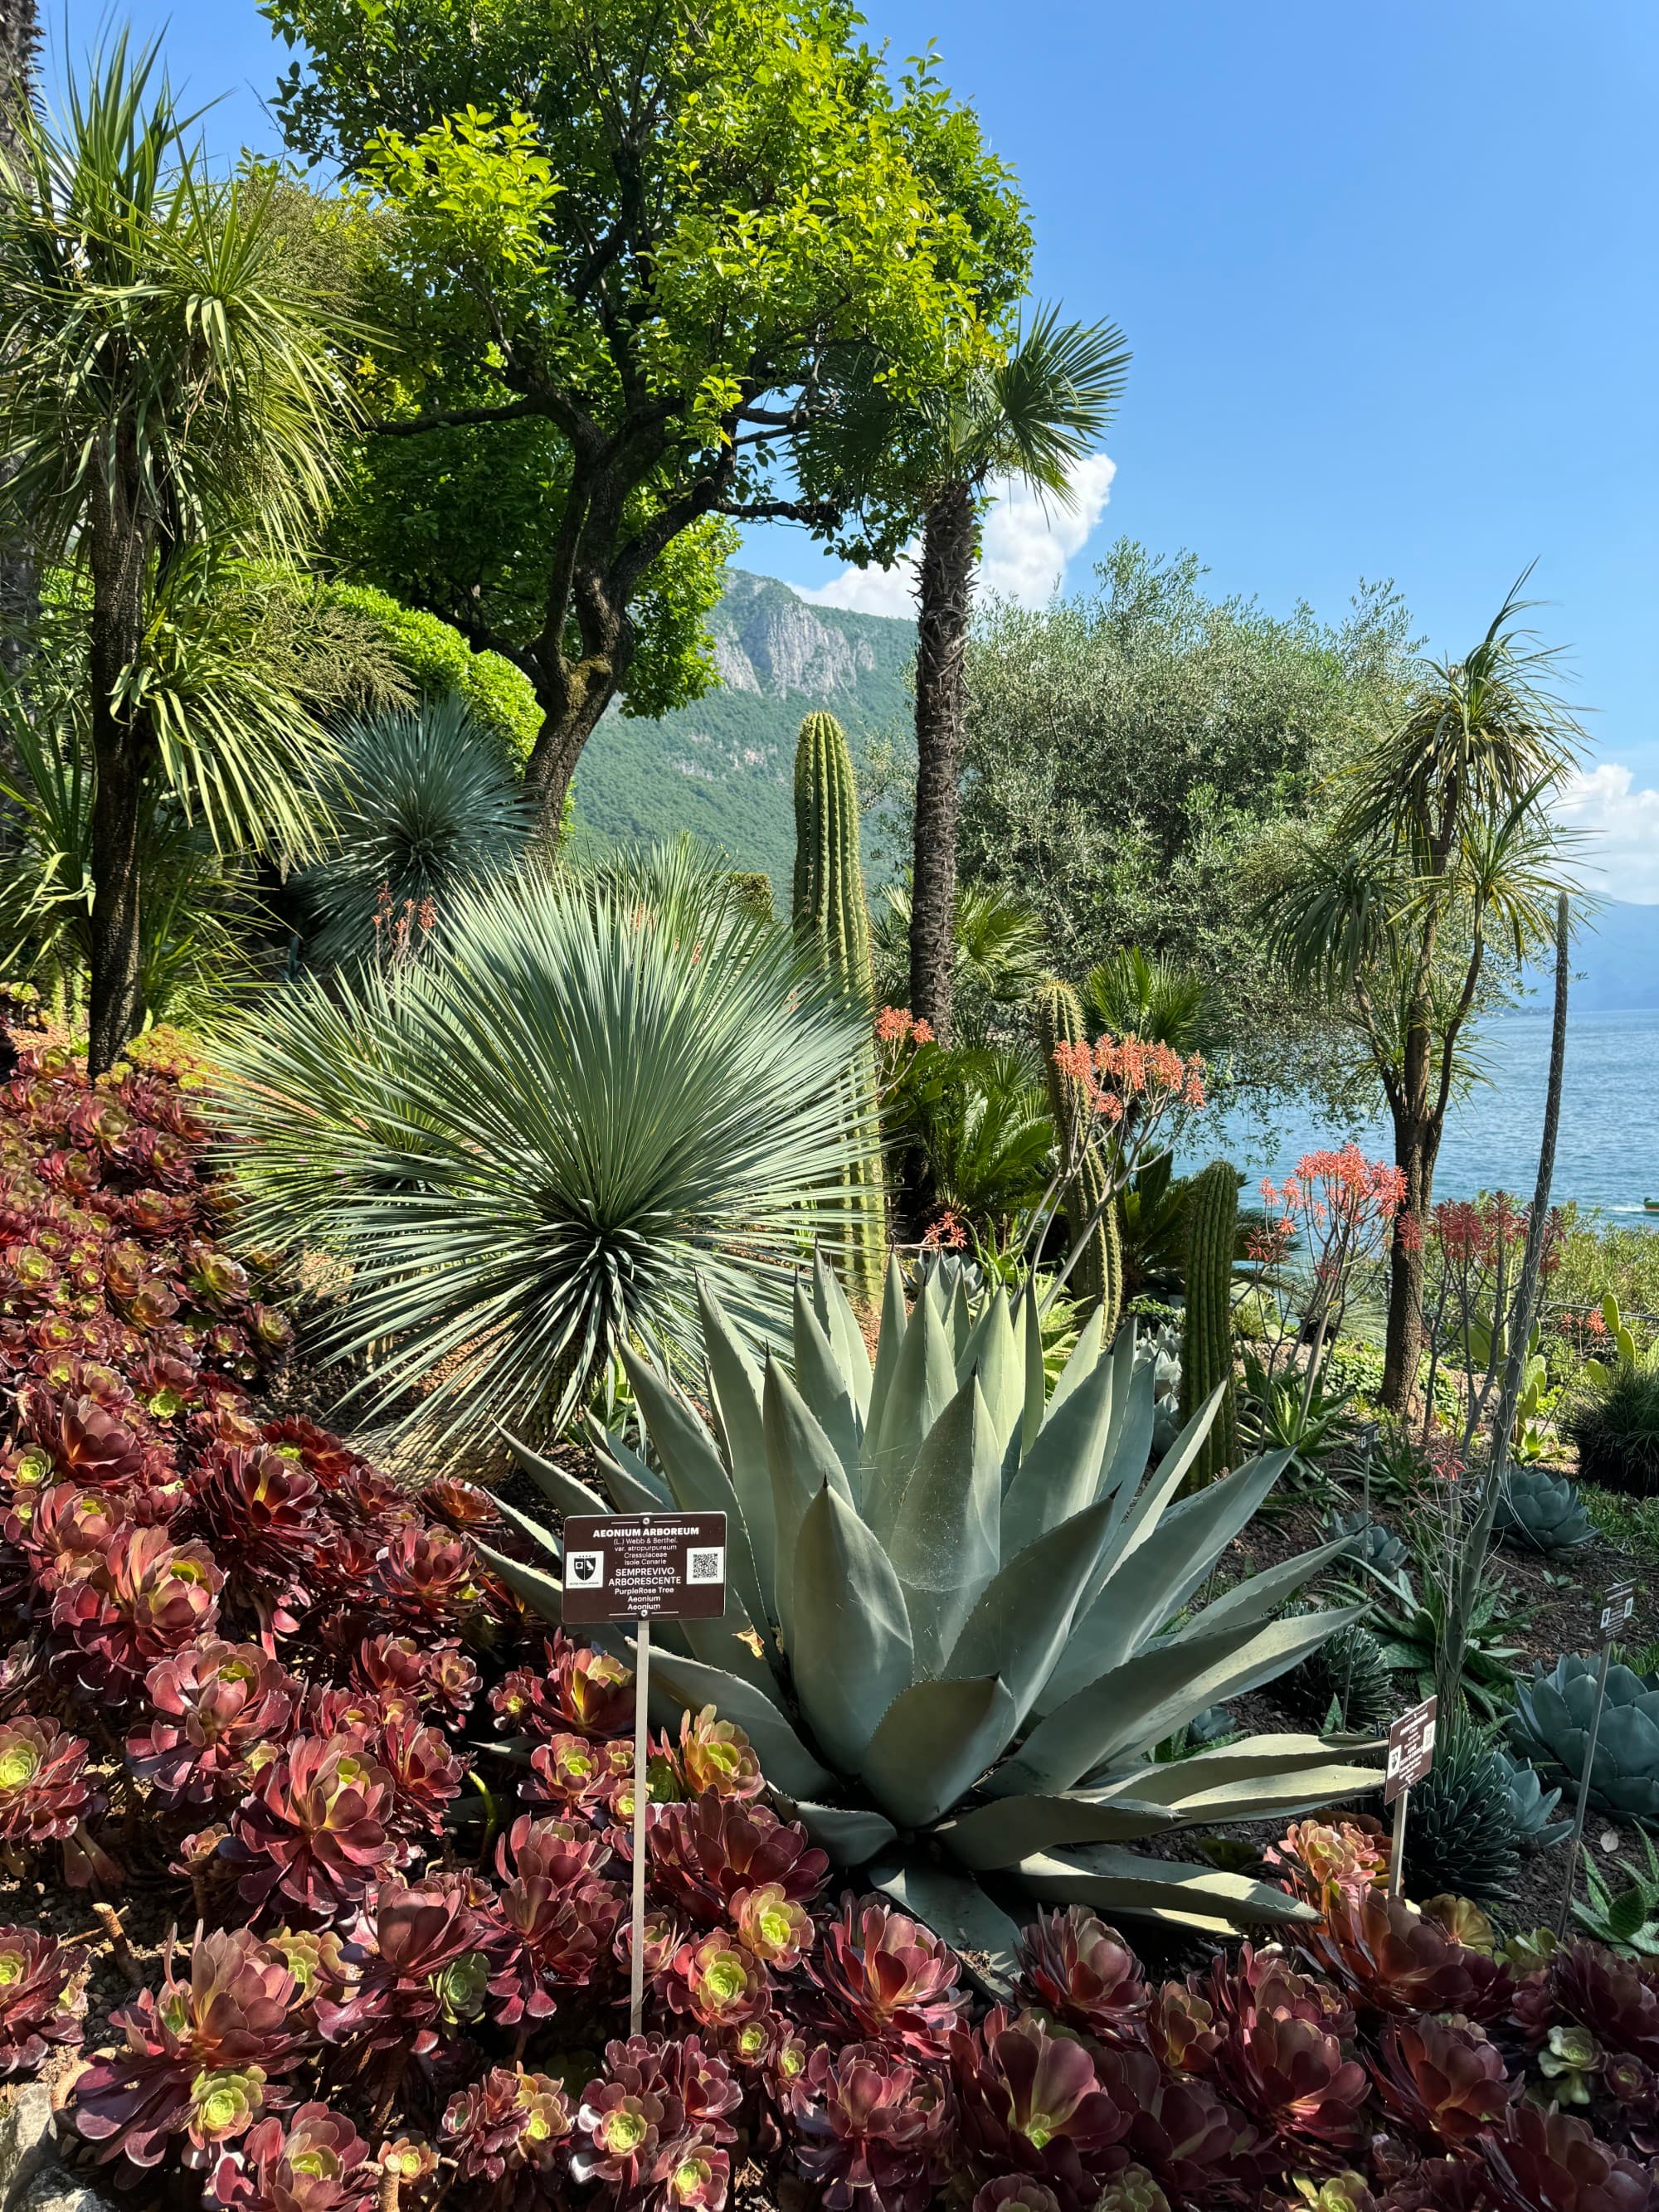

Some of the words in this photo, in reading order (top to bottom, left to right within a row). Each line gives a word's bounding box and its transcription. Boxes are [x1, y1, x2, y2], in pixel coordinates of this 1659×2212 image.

[592, 1529, 641, 1538] AEONIUM
[642, 1527, 699, 1536] ARBOREUM
[615, 1567, 675, 1577] SEMPREVIVO
[608, 1576, 681, 1587] ARBORESCENTE
